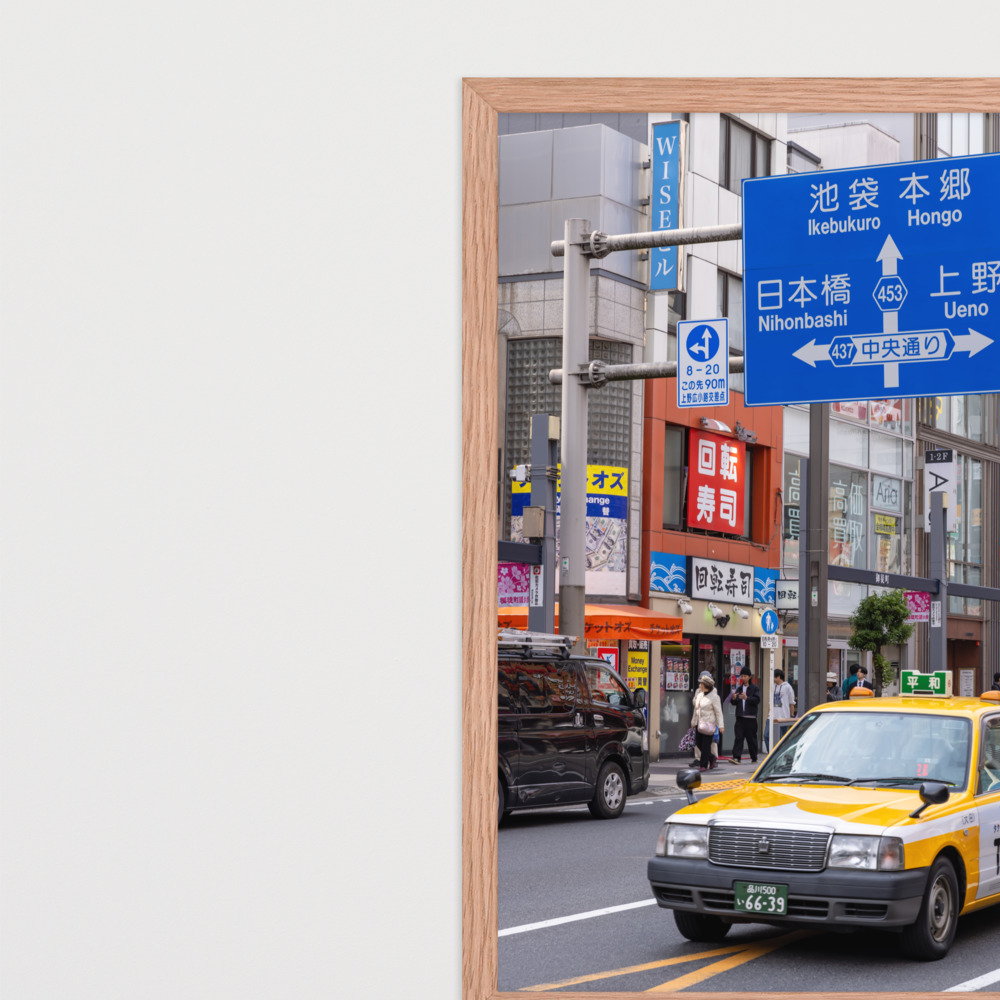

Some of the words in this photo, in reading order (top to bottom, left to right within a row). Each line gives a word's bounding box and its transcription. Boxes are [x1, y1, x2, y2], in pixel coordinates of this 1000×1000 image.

[810, 177, 879, 213] 池袋
[899, 167, 971, 205] 本郷
[655, 136, 677, 277] WISEル
[808, 216, 881, 236] Ikebukuro
[907, 209, 963, 228] Hongo
[757, 273, 852, 311] 日本橋
[877, 284, 903, 303] 453
[944, 301, 989, 319] Ueno
[758, 310, 848, 332] Nihonbashi
[831, 343, 854, 360] 437
[861, 335, 941, 360] 中央通り
[698, 438, 738, 483] 回転
[696, 484, 738, 528] 寿司
[695, 565, 752, 598] 回転寿司
[778, 590, 797, 600] 回転
[585, 621, 632, 633] ケットオズ
[627, 665, 648, 674] Exchange
[630, 656, 645, 665] Money
[906, 676, 941, 690] 平和
[745, 894, 785, 912] 66-39
